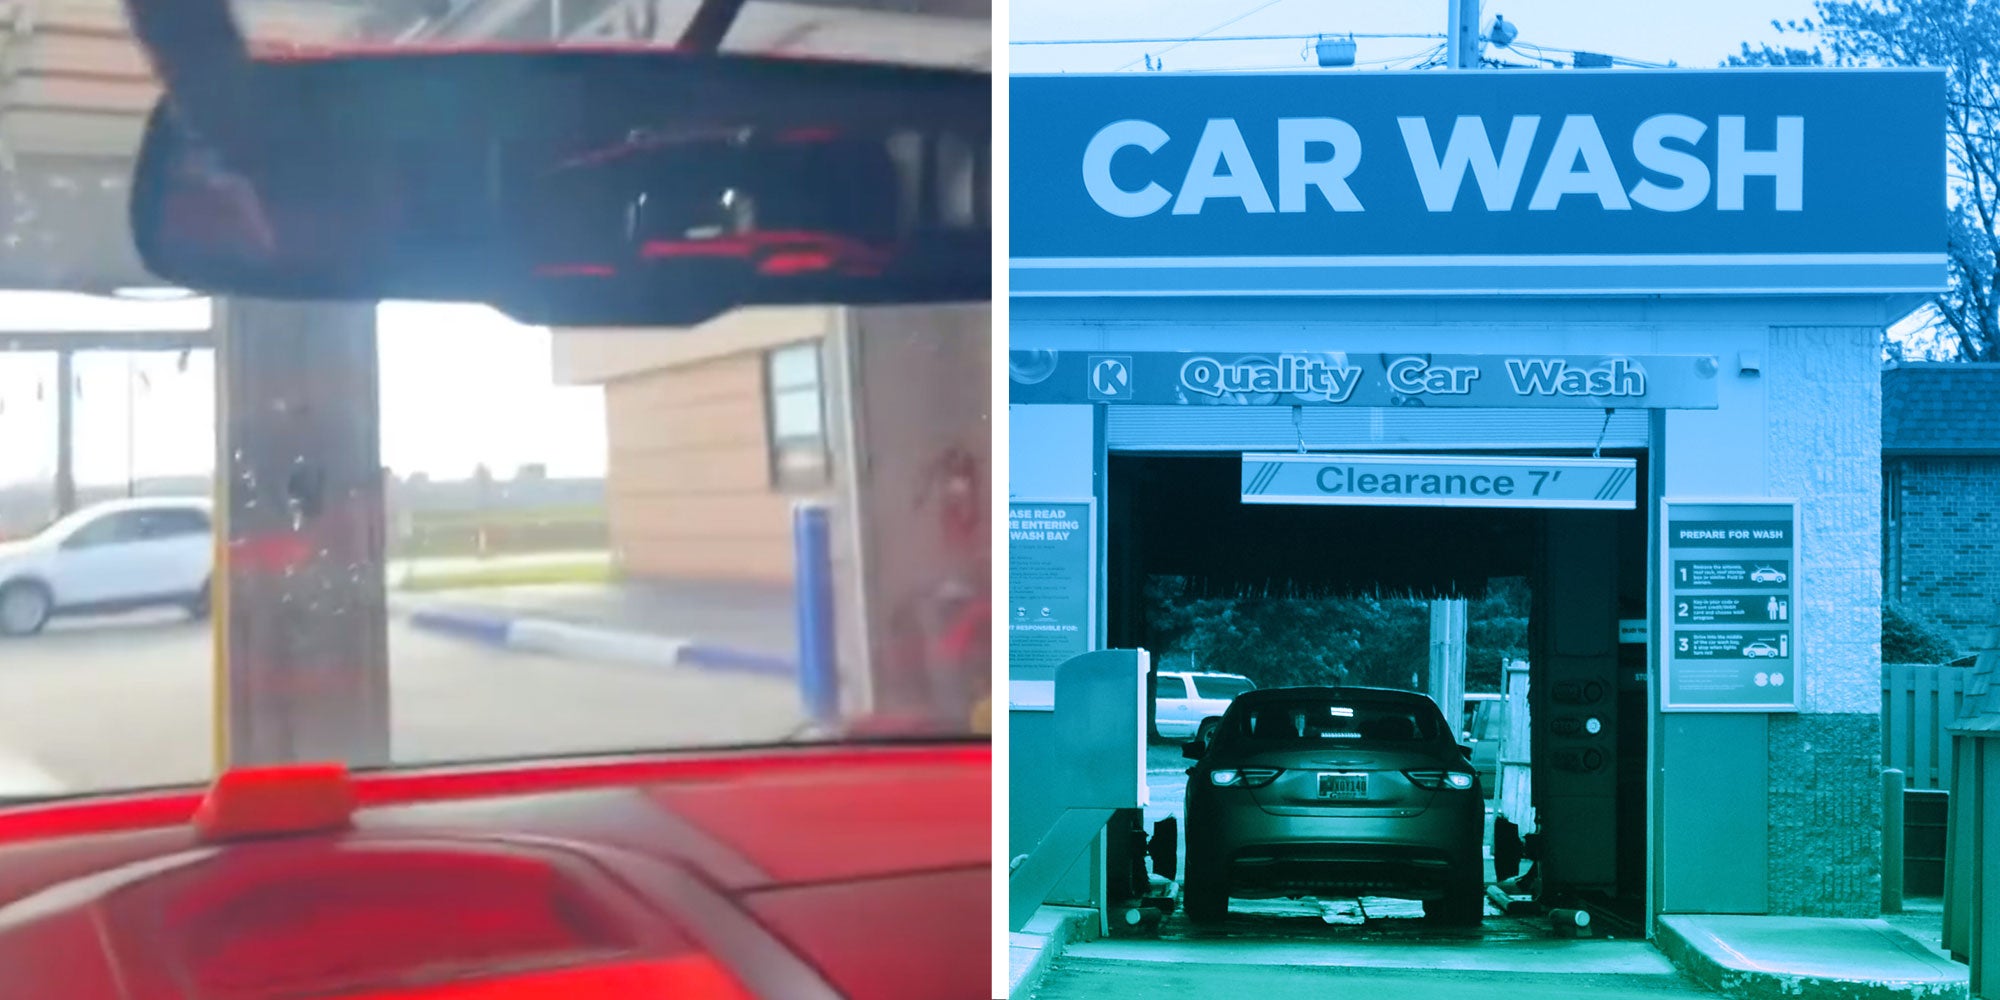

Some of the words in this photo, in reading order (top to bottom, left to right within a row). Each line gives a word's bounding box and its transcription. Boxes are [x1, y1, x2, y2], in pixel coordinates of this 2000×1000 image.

[1082, 117, 1365, 218] CAR
[1397, 113, 1804, 212] WASH
[1092, 358, 1128, 396] K
[1180, 354, 1363, 402] Quality
[1386, 356, 1480, 395] Car
[1504, 358, 1646, 397] Wash
[1316, 466, 1515, 497] Clearance
[1034, 509, 1067, 519] READ
[1021, 520, 1080, 530] ENTERING
[1010, 531, 1045, 541] WASH
[1046, 531, 1070, 541] BAY
[1680, 530, 1726, 540] PREPARE
[1729, 530, 1750, 540] FOR
[1753, 530, 1784, 540] WASH
[1680, 568, 1688, 582] 1
[1678, 603, 1689, 617] 2
[1679, 638, 1689, 651] 3
